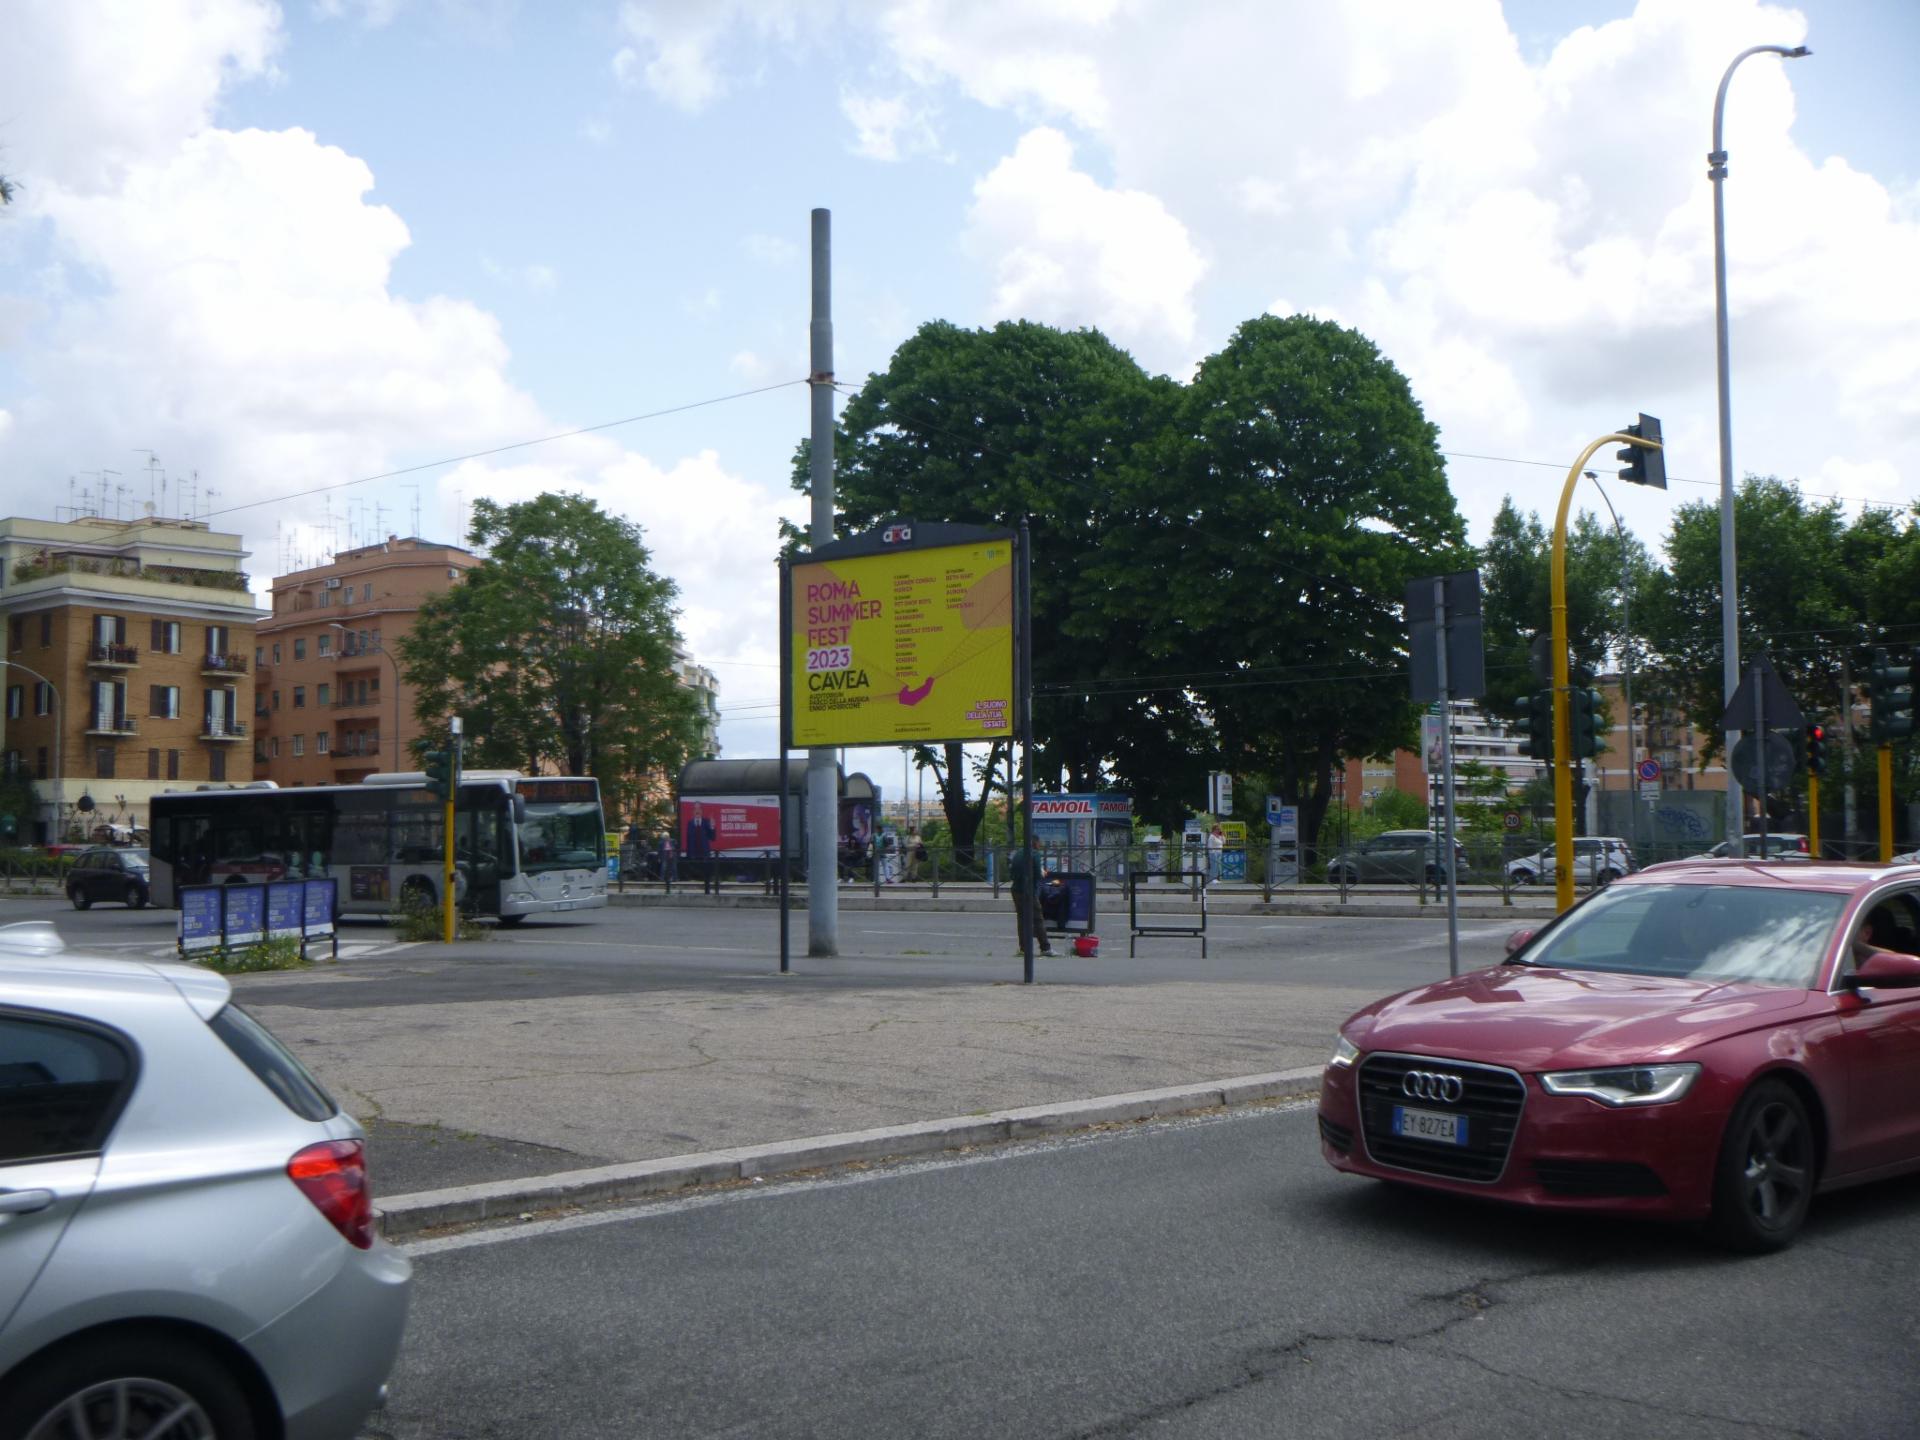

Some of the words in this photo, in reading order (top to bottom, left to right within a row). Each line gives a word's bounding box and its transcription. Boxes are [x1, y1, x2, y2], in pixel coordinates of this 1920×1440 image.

[807, 580, 862, 602] ROMA
[808, 600, 882, 625] SUMMER
[807, 625, 851, 648] FEST
[808, 648, 850, 669] 2023
[808, 669, 870, 692] CAVEA
[1032, 800, 1093, 814] TAMOIL
[1100, 802, 1132, 812] TAMOIL
[1507, 816, 1517, 825] 20
[1402, 1113, 1417, 1131] EY
[1420, 1116, 1455, 1138] 827EA
